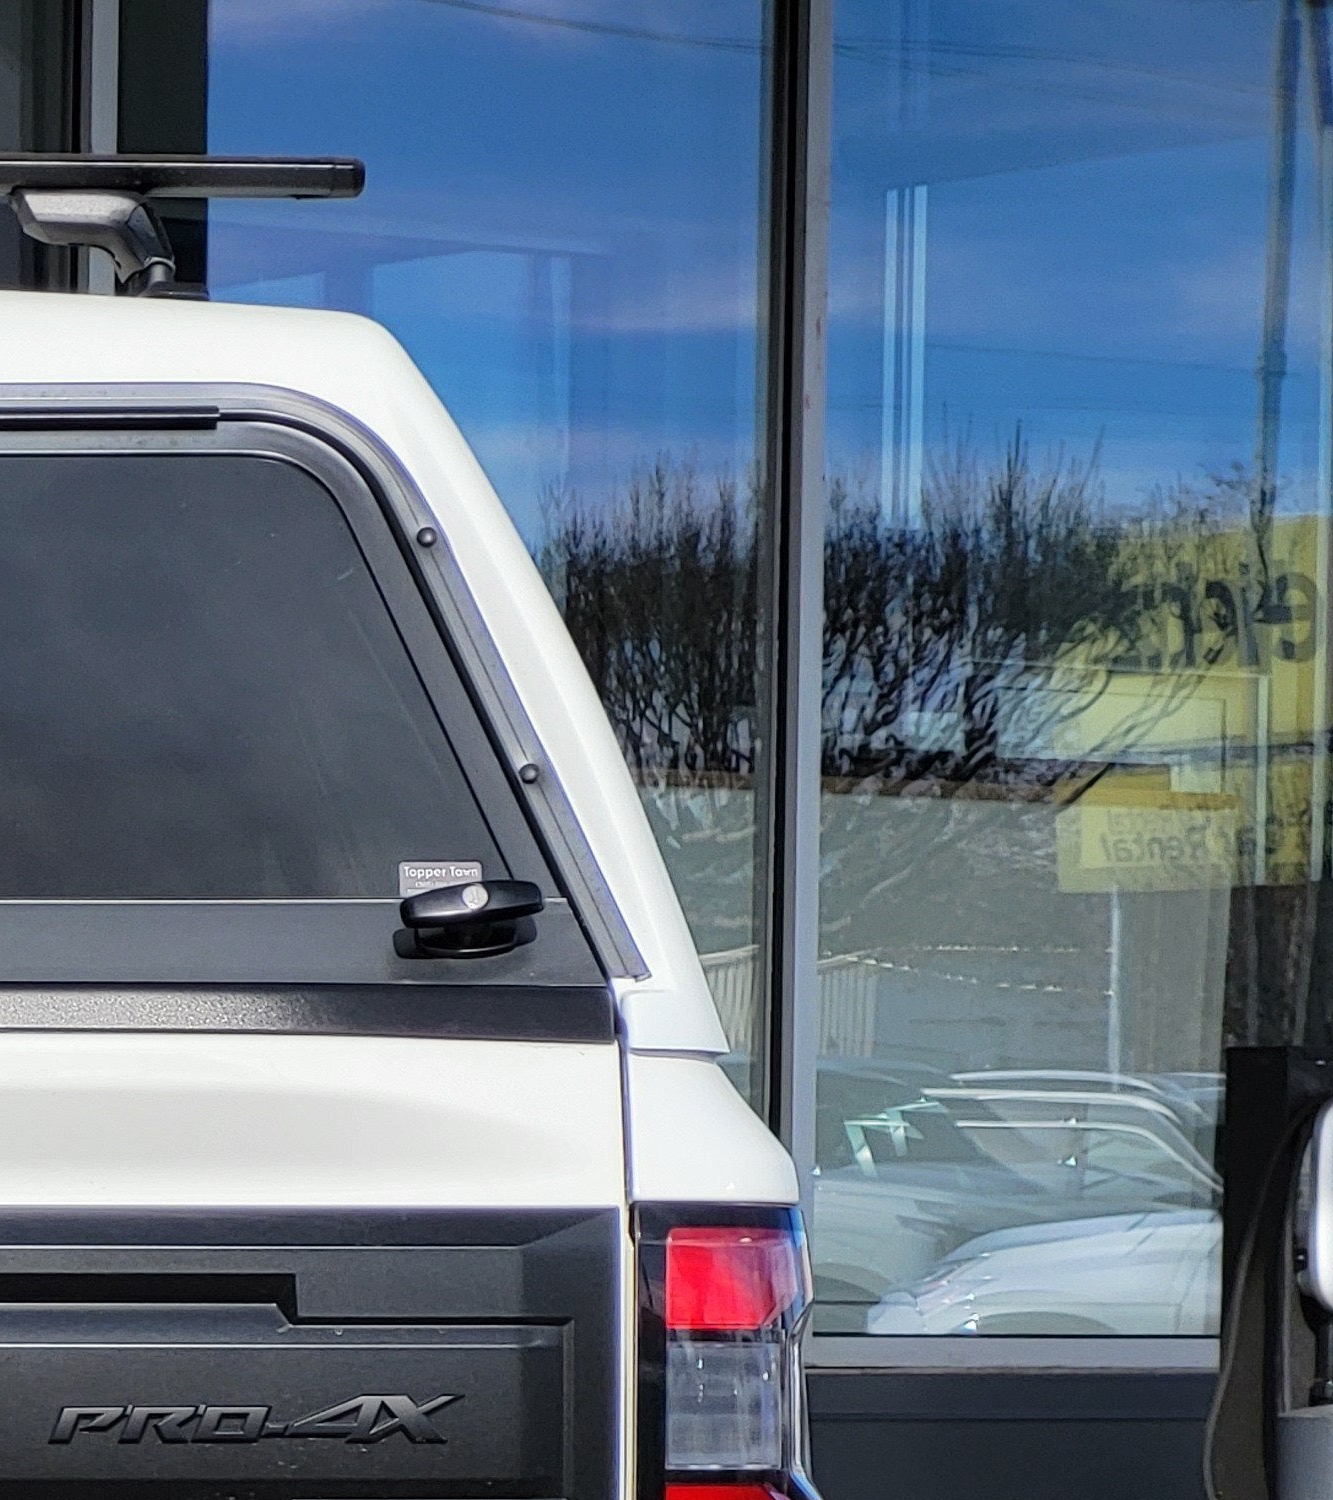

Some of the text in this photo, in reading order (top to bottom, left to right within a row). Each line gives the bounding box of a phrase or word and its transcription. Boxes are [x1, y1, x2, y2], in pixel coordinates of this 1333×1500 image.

[403, 866, 479, 879] Topper Town
[48, 1393, 466, 1444] PRO-4X
